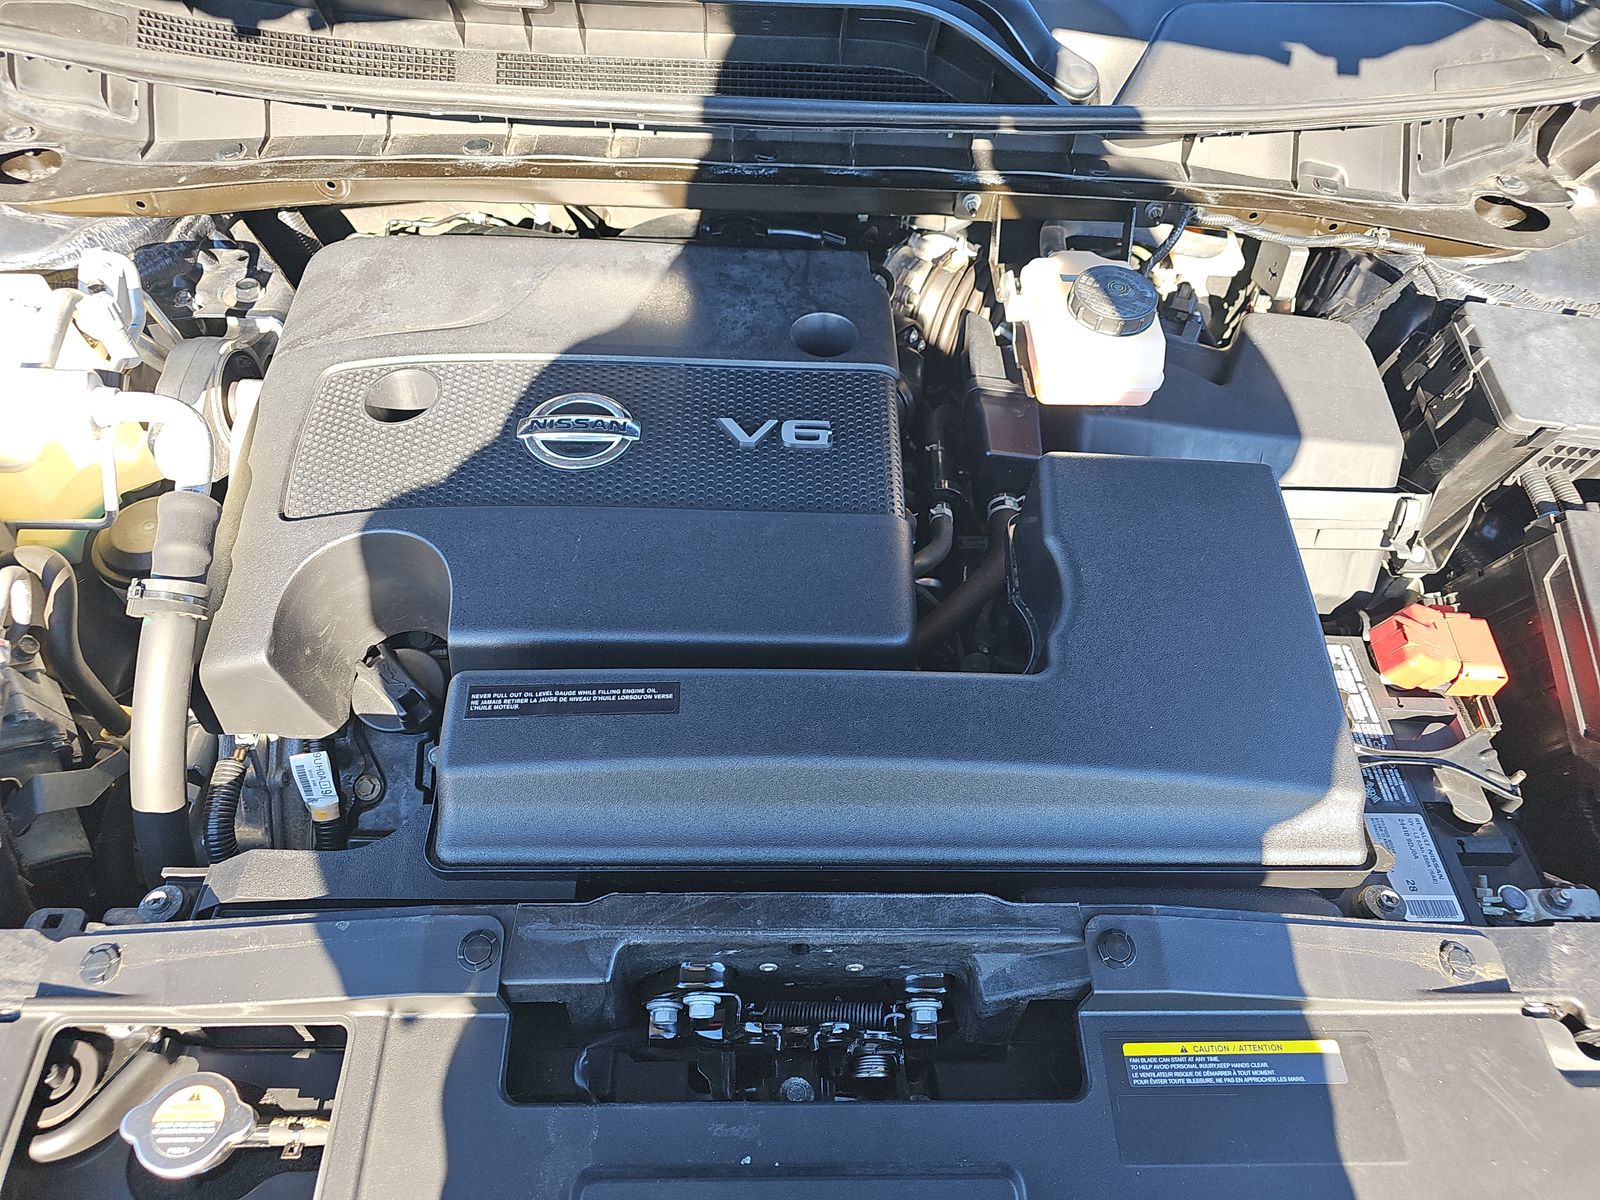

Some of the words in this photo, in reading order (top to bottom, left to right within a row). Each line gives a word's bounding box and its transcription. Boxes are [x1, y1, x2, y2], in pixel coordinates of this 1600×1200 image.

[529, 418, 628, 432] NISSAN
[716, 417, 833, 448] V6
[1414, 818, 1430, 845] RENAULT
[1428, 849, 1444, 879] NISSAN
[1406, 880, 1418, 891] 28
